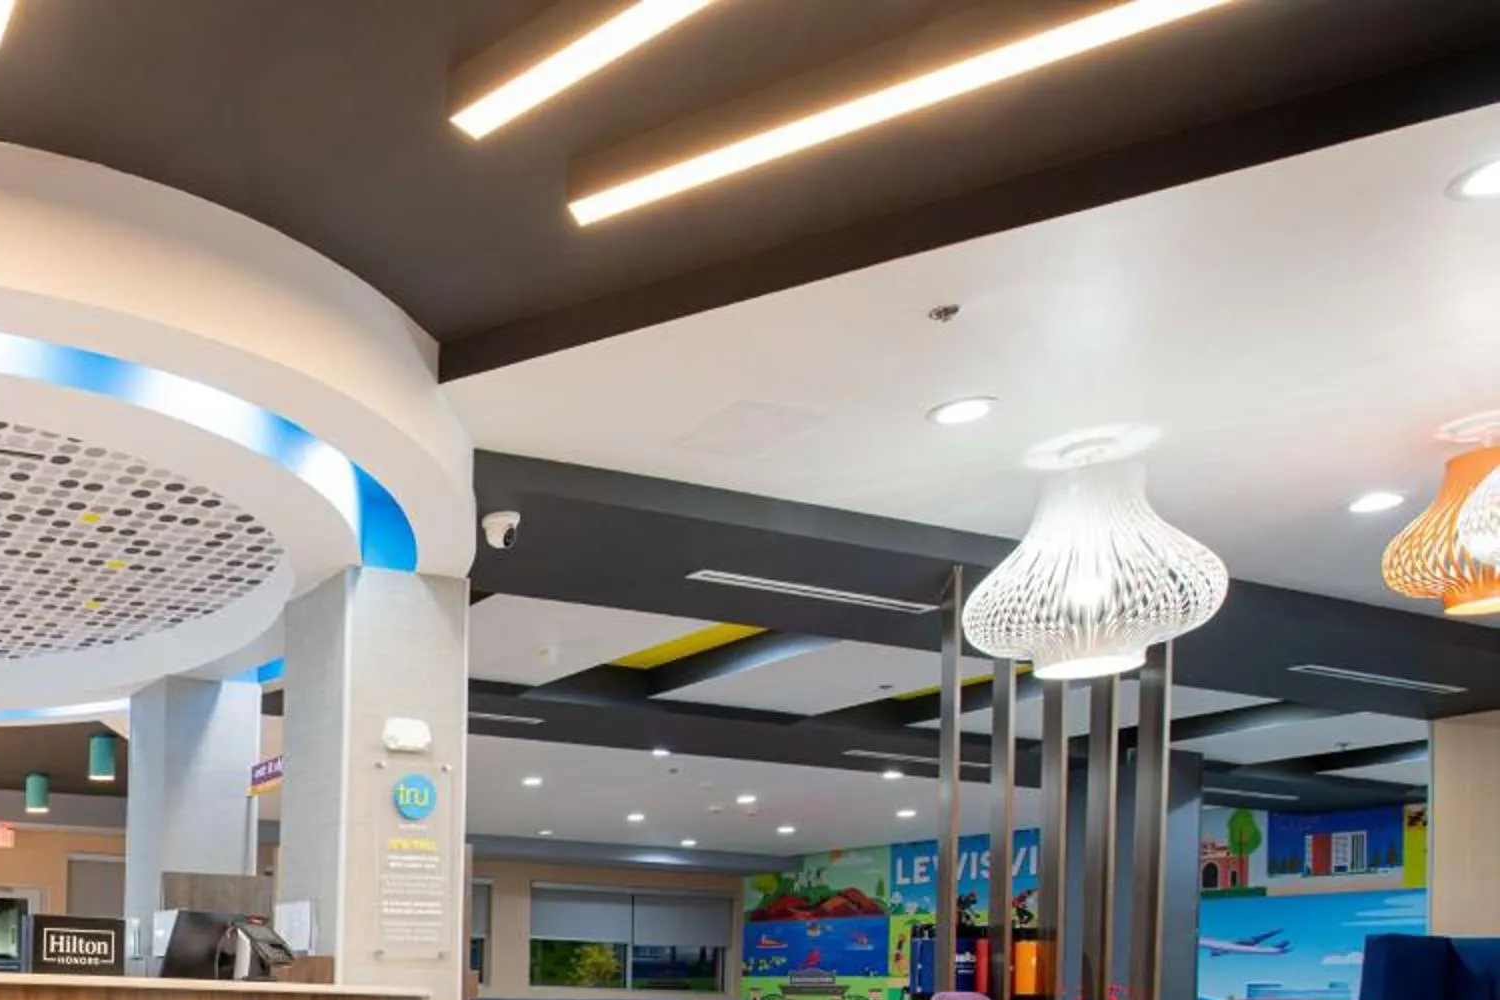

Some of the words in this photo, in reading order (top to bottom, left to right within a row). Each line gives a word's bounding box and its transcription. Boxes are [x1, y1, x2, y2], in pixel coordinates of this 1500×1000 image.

[396, 783, 429, 807] tru
[49, 933, 109, 955] Hilton
[57, 956, 100, 966] HONORS
